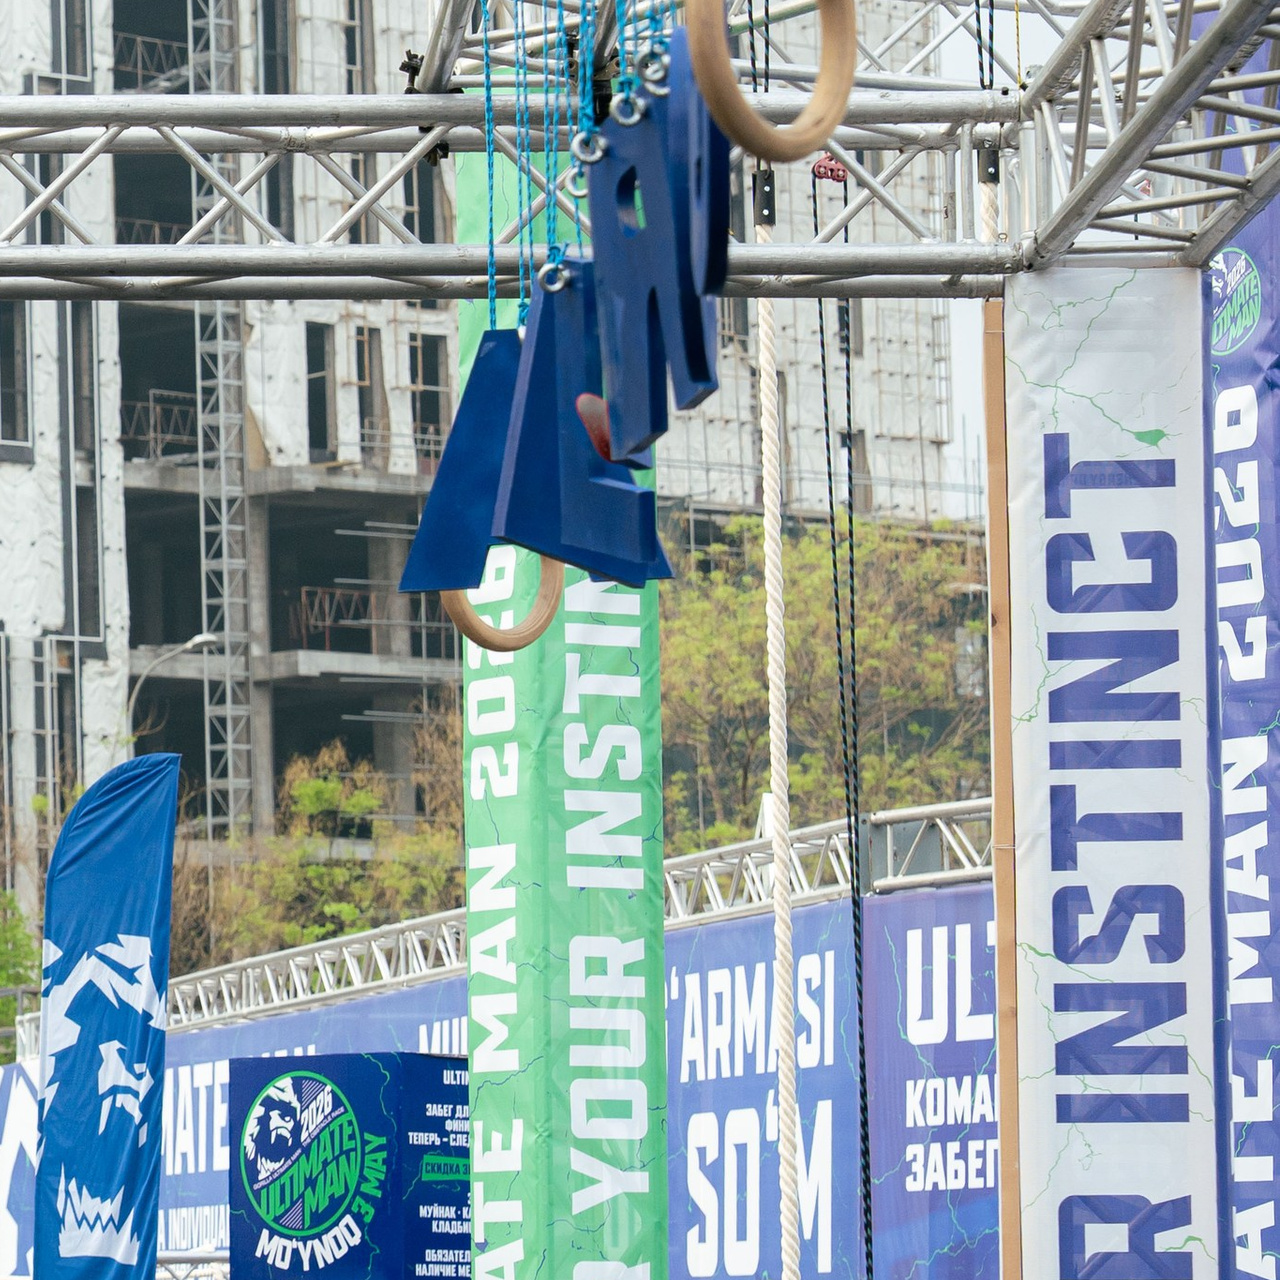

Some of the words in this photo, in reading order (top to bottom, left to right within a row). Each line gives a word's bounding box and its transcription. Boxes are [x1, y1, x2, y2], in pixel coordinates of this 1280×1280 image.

[1044, 432, 1190, 1124] INSTINCT
[1222, 735, 1274, 1005] MAN
[467, 843, 518, 1074] MAN
[569, 935, 649, 1216] YOUR
[301, 1084, 333, 1143] 2026
[408, 1131, 441, 1146] ТЕПЕРЬ
[426, 1103, 453, 1118] ЗАБЕГ
[260, 1119, 356, 1221] ULTIMATE
[304, 1151, 357, 1229] MAN
[360, 1132, 387, 1198] MAY
[425, 1162, 460, 1176] СКИДКА
[351, 1195, 375, 1223] 3
[419, 1203, 456, 1219] МУЙНАК
[415, 1263, 456, 1277] НАЛИЧИЕ
